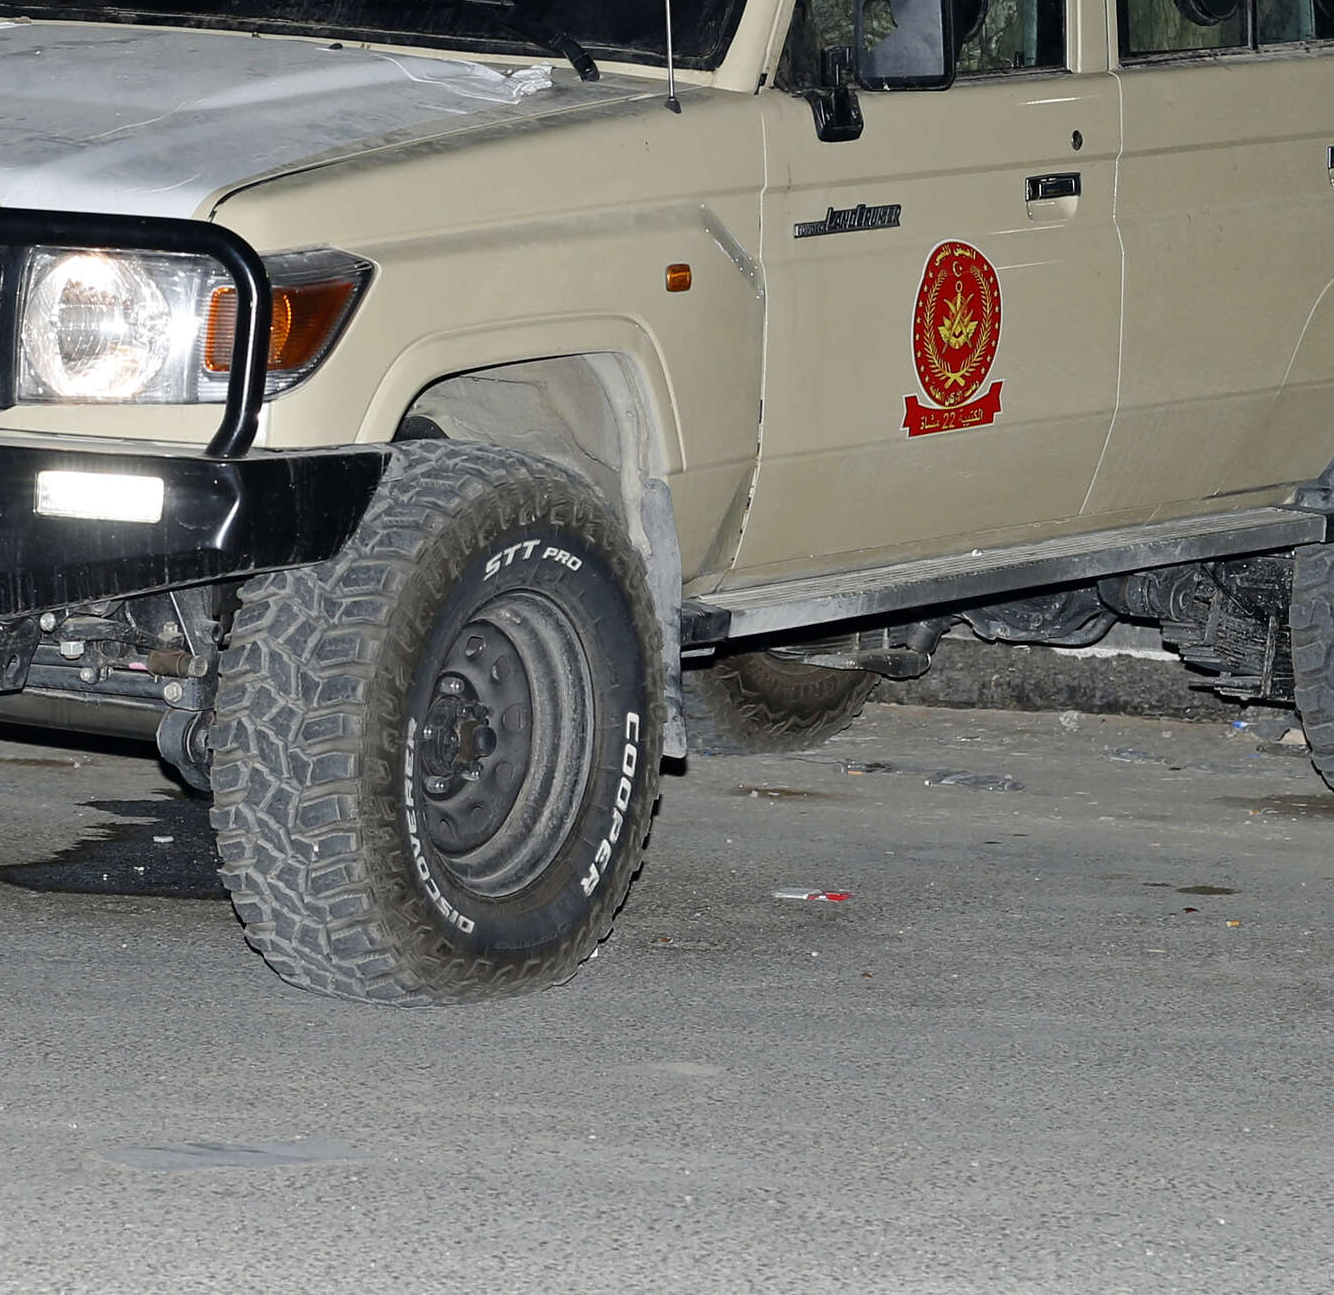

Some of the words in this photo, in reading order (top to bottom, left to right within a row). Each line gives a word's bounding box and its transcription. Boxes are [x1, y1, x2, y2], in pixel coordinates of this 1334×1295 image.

[942, 411, 956, 430] 22
[482, 538, 541, 582] STT
[541, 546, 583, 573] PRO
[404, 715, 476, 935] DISCOVERER
[580, 711, 641, 899] COOPER
